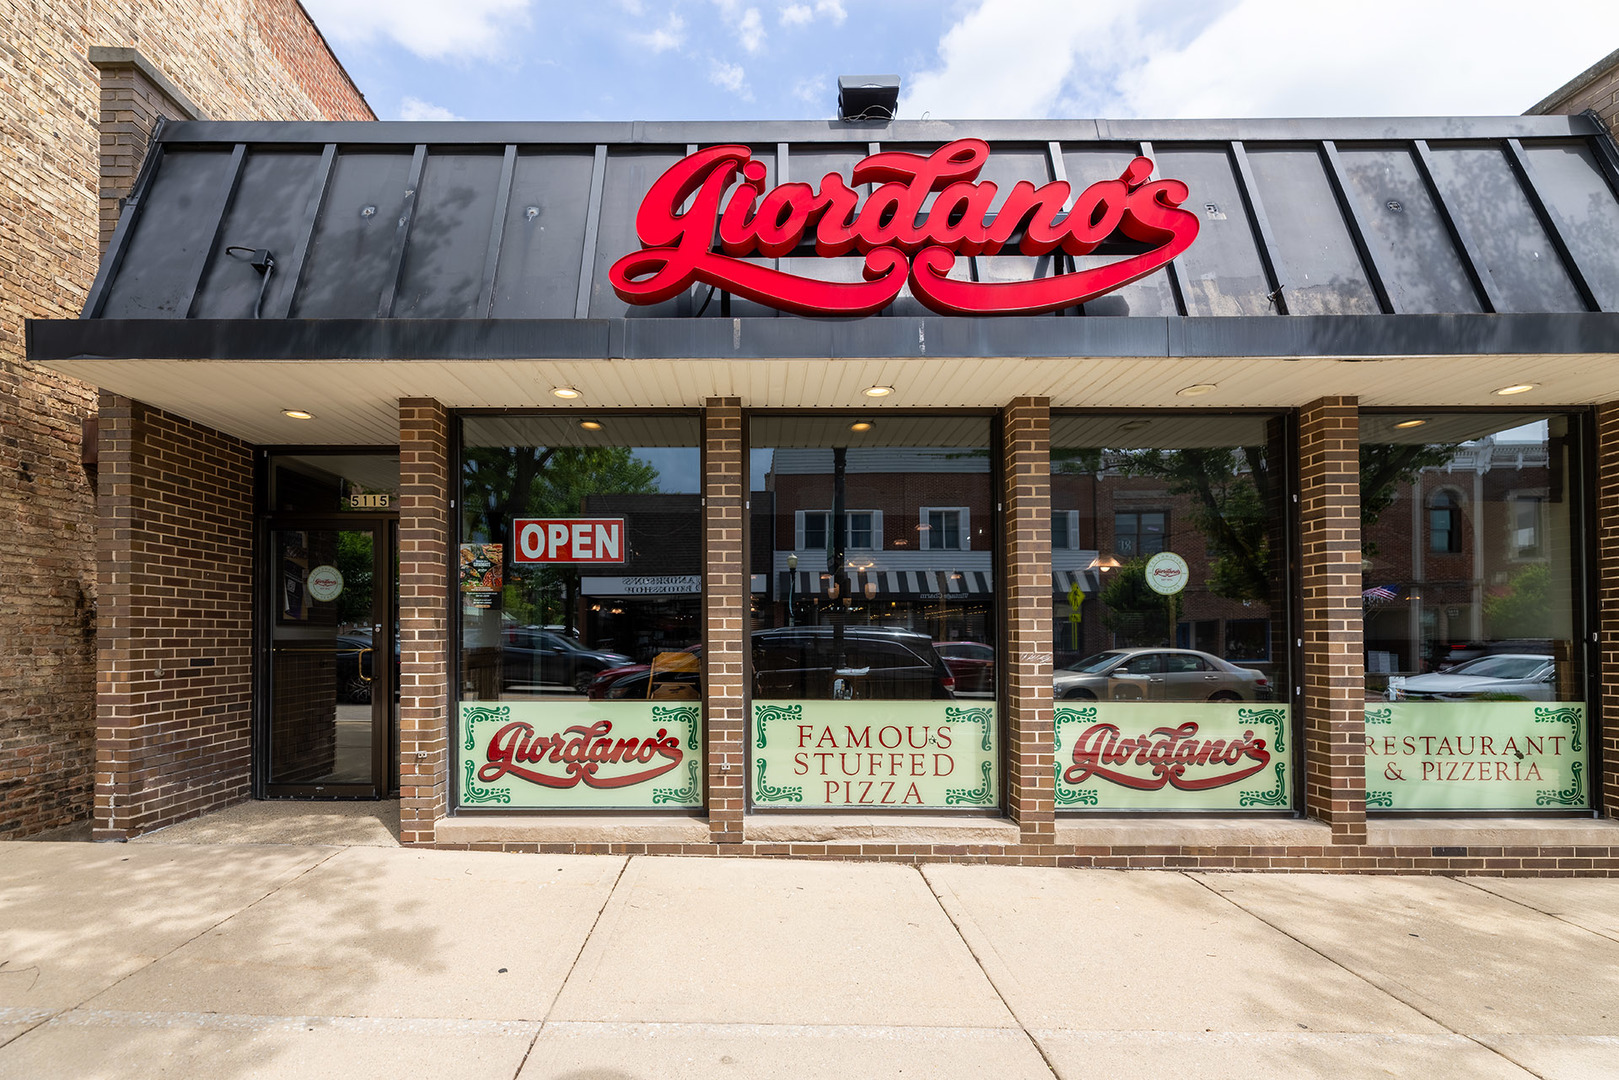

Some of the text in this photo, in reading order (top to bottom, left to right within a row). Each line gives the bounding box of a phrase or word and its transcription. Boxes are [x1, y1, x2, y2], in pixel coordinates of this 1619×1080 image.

[608, 137, 1200, 317] Giordano's
[351, 495, 387, 507] 5115
[520, 523, 619, 559] OPEN
[797, 725, 953, 749] FAMOUS
[1364, 735, 1567, 756] RESTAURANT
[477, 719, 684, 789] Giordano's
[794, 753, 956, 777] STUFFED
[1063, 720, 1272, 791] Giordano's
[1384, 761, 1544, 781] & PIZZERIA
[824, 781, 925, 805] PIZZA
